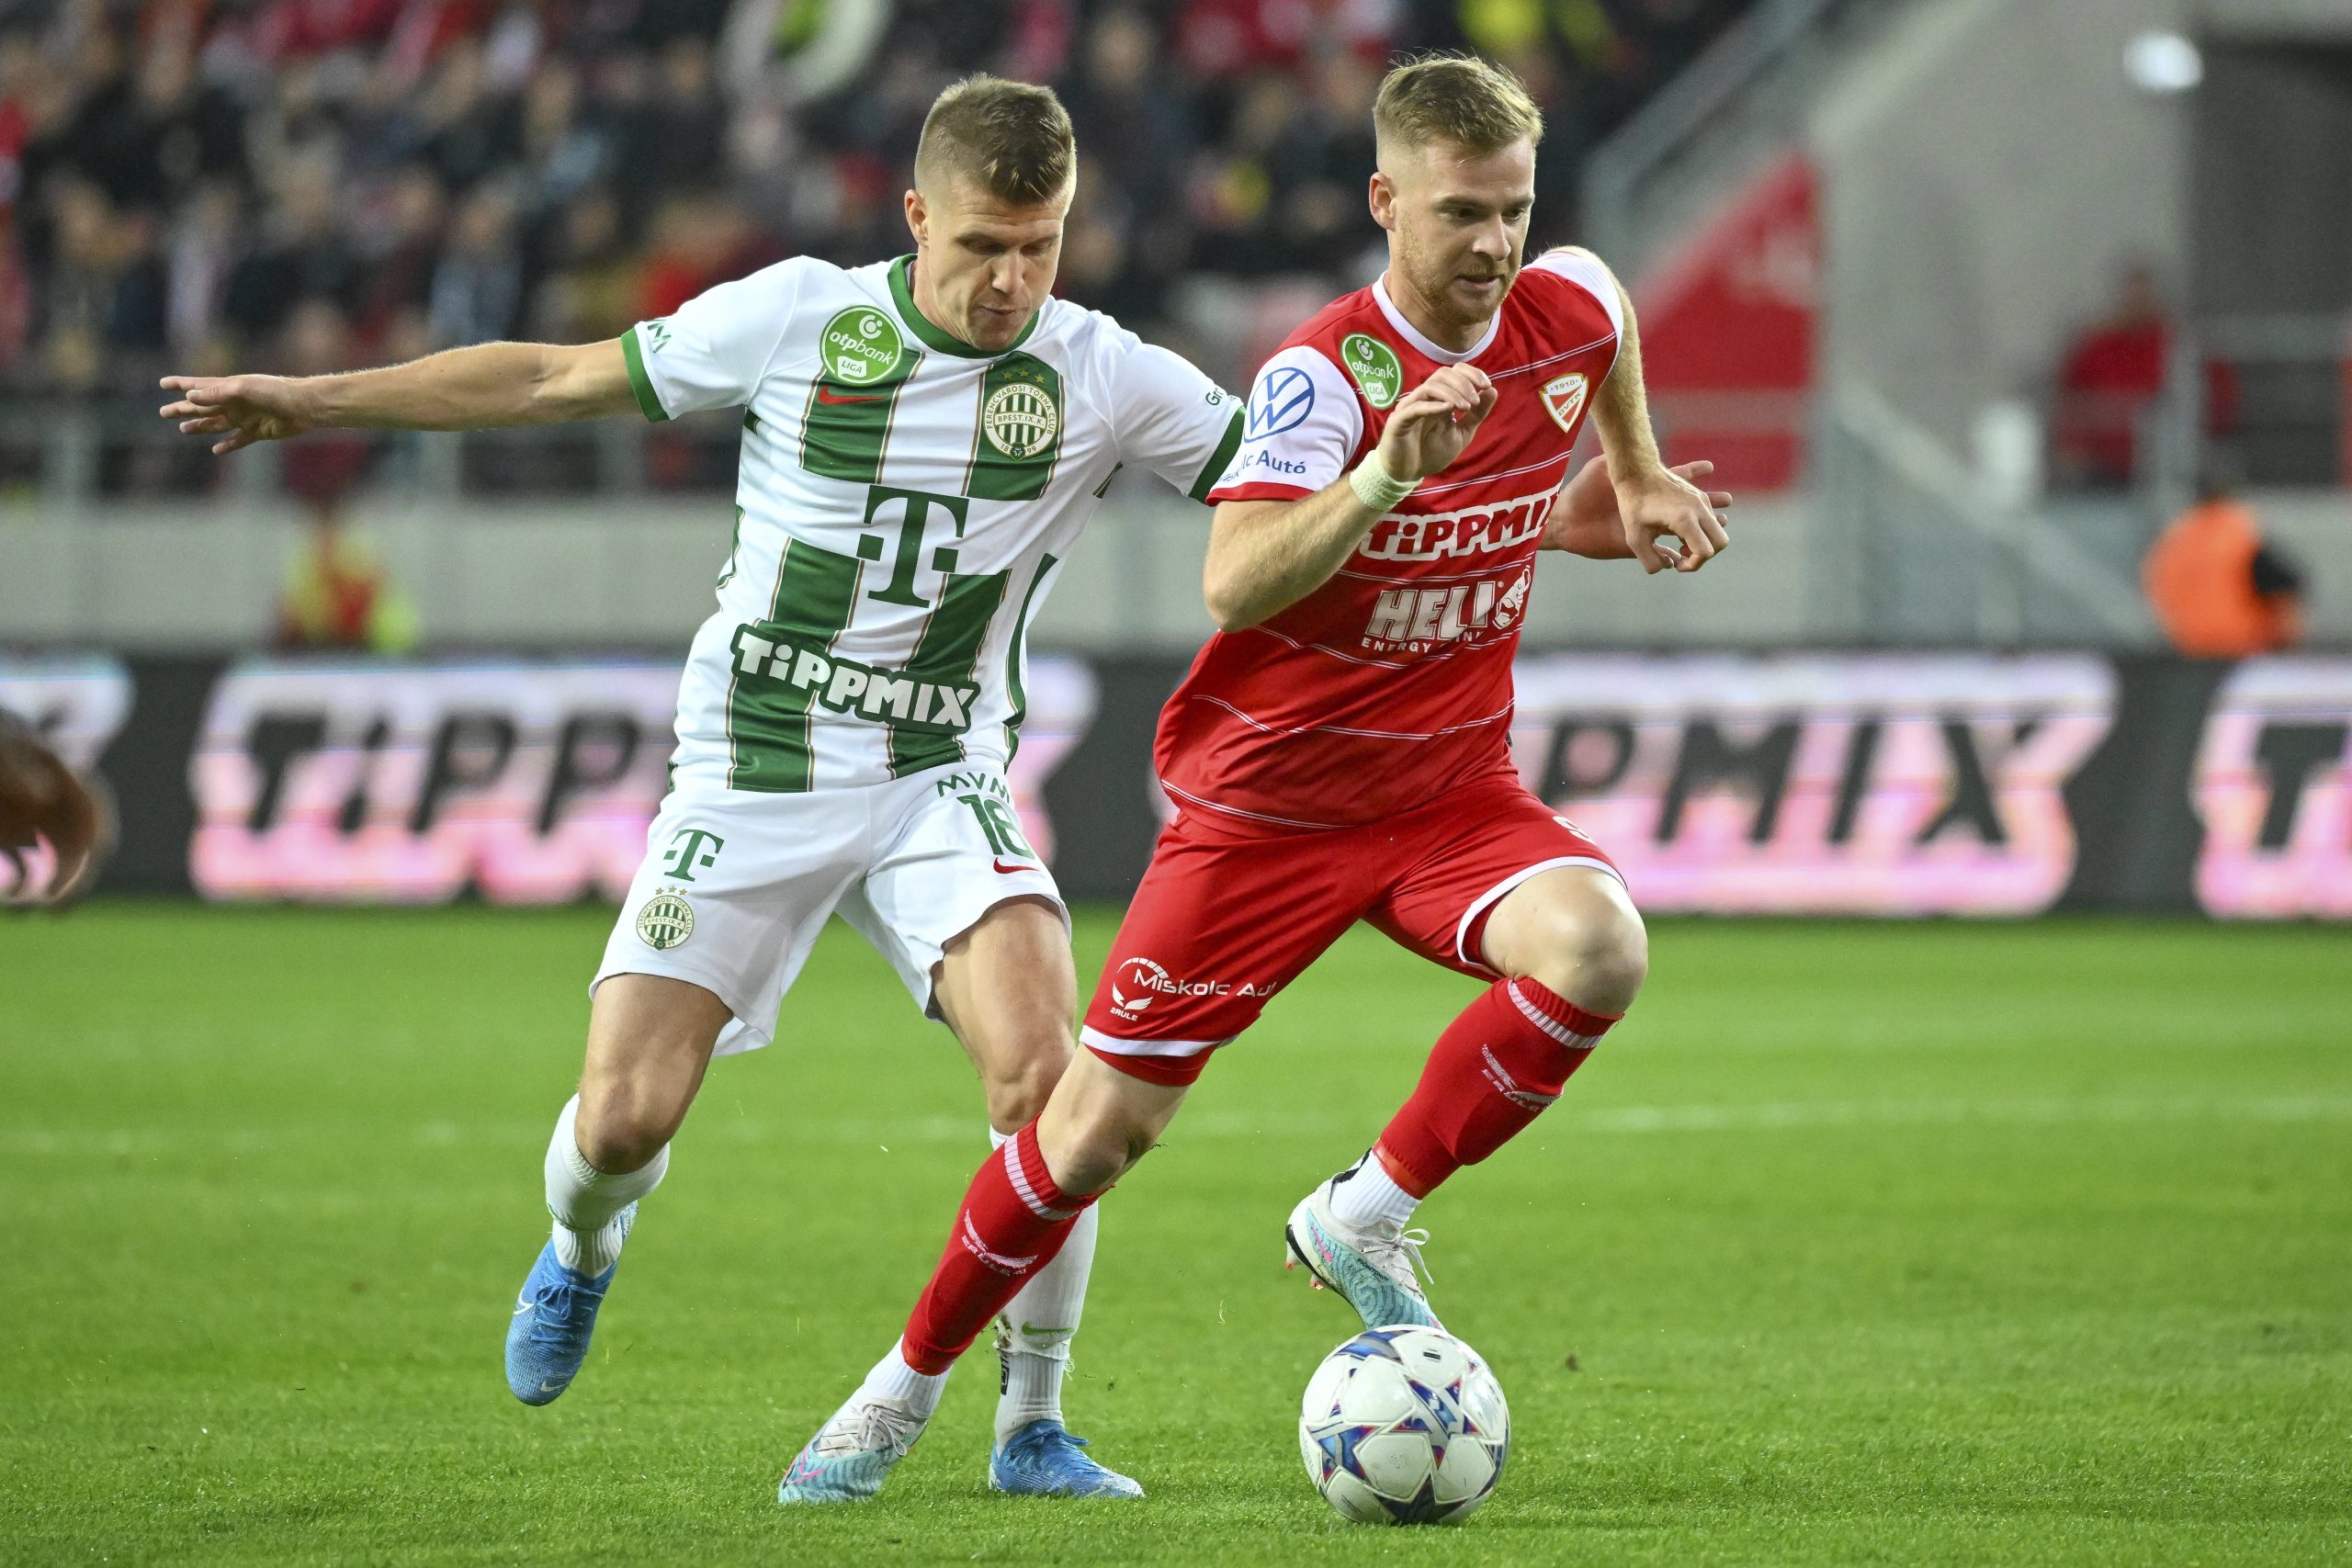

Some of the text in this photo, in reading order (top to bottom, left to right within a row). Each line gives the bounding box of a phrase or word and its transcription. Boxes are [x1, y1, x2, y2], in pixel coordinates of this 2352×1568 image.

[830, 332, 894, 365] otpbank
[842, 360, 863, 373] LIGA
[1351, 360, 1395, 379] otpbank
[1369, 386, 1385, 396] LIGA
[1554, 379, 1576, 390] 1910
[1029, 387, 1052, 410] TORNA
[1046, 412, 1056, 435] CLUB
[1557, 391, 1581, 416] DVTK
[1256, 449, 1306, 474] Autó
[1361, 637, 1431, 653] ENERGY
[936, 772, 1010, 804] MVM
[673, 898, 691, 917] TORNA
[684, 918, 693, 935] CLUB
